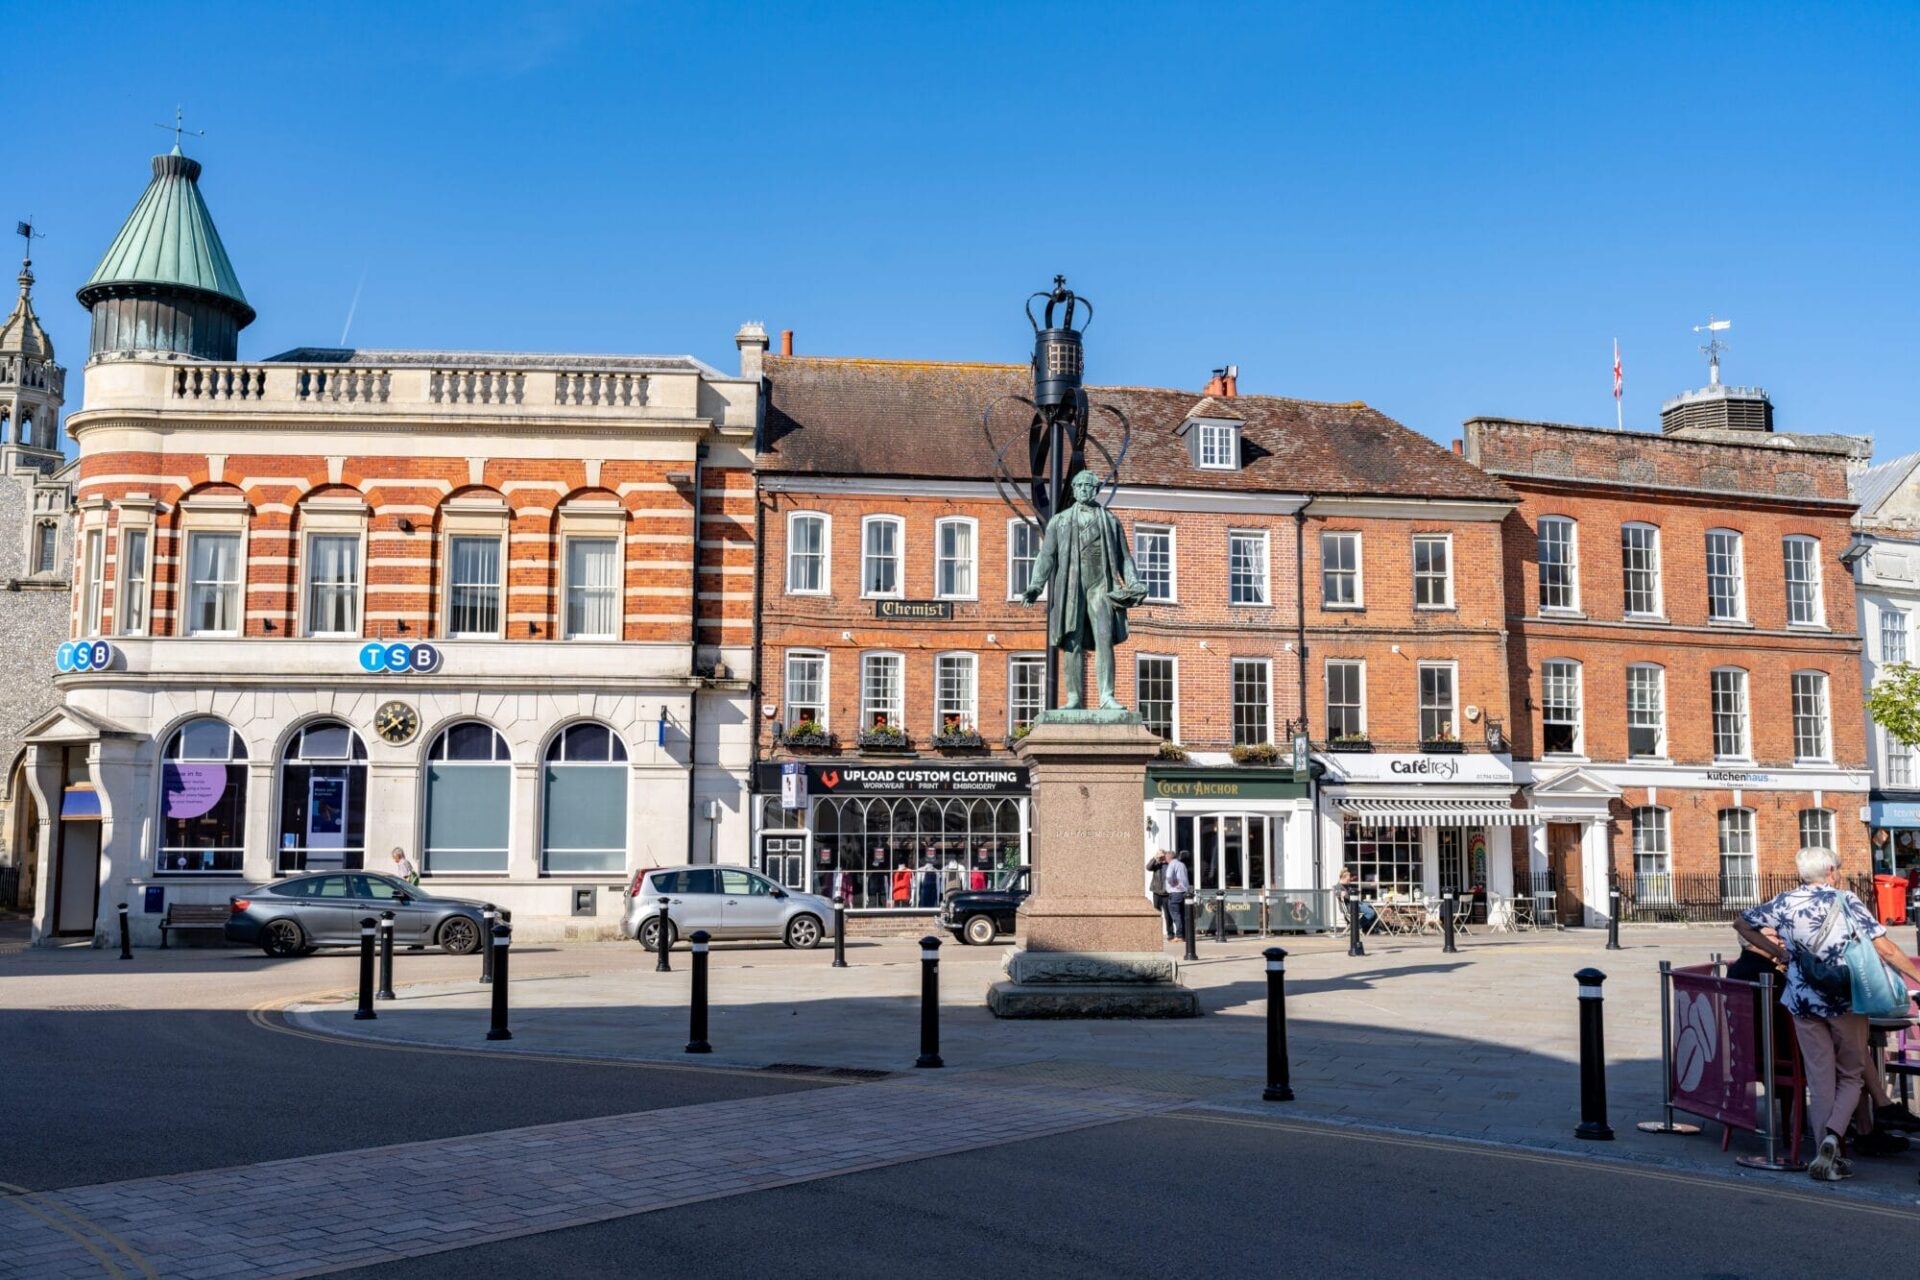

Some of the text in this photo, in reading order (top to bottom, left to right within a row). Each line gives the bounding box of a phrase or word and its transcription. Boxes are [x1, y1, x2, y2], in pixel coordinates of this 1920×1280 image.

[882, 602, 945, 616] Chemist
[60, 645, 107, 667] TSB
[366, 647, 433, 668] TSB
[843, 770, 1017, 783] UPLOAD CUSTOM CLOTHING
[863, 782, 905, 790] WORKWEAR
[918, 782, 939, 790] PRINT
[1157, 779, 1239, 797] COCKY ANCHOR
